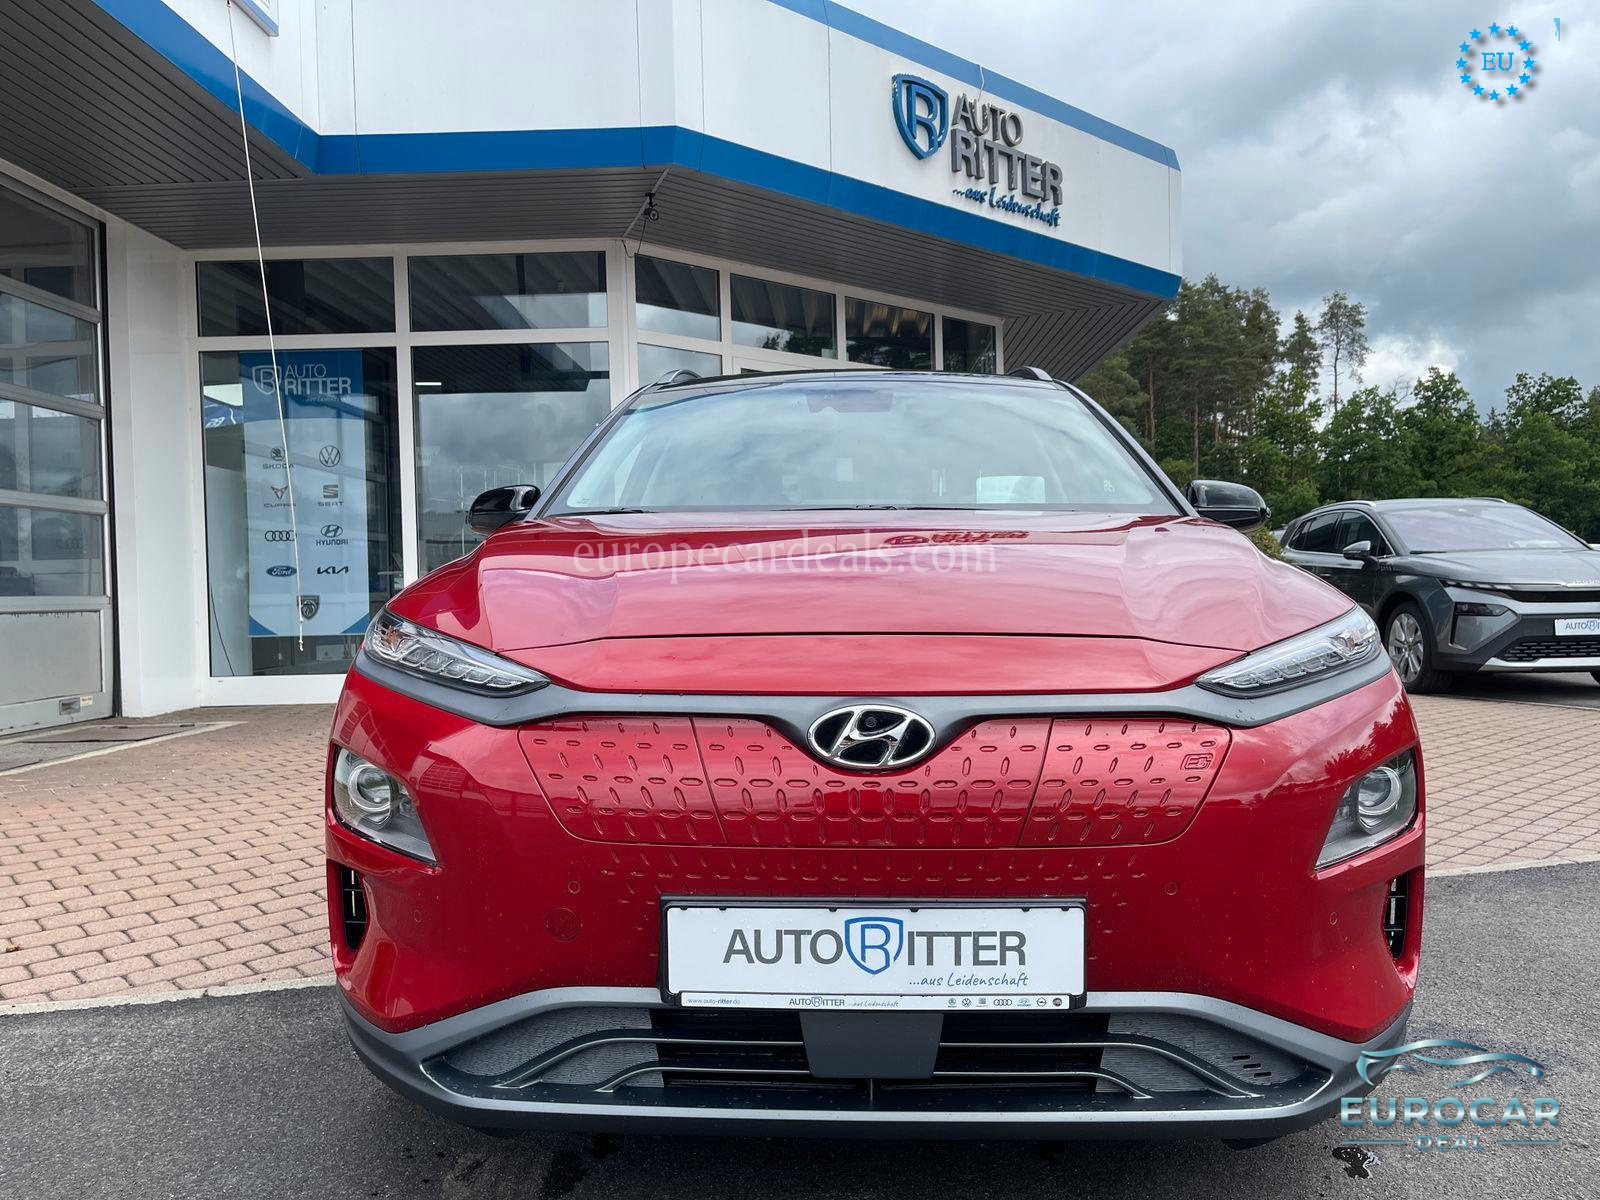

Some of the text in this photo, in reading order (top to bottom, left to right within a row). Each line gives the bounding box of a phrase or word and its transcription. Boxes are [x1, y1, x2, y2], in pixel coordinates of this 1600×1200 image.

[952, 93, 1023, 147] AUTO
[951, 129, 1063, 206] RITTER
[285, 363, 326, 378] AUTO
[284, 377, 352, 396] RITTER
[271, 567, 292, 576] Ford
[948, 972, 1028, 987] Leidenschaft
